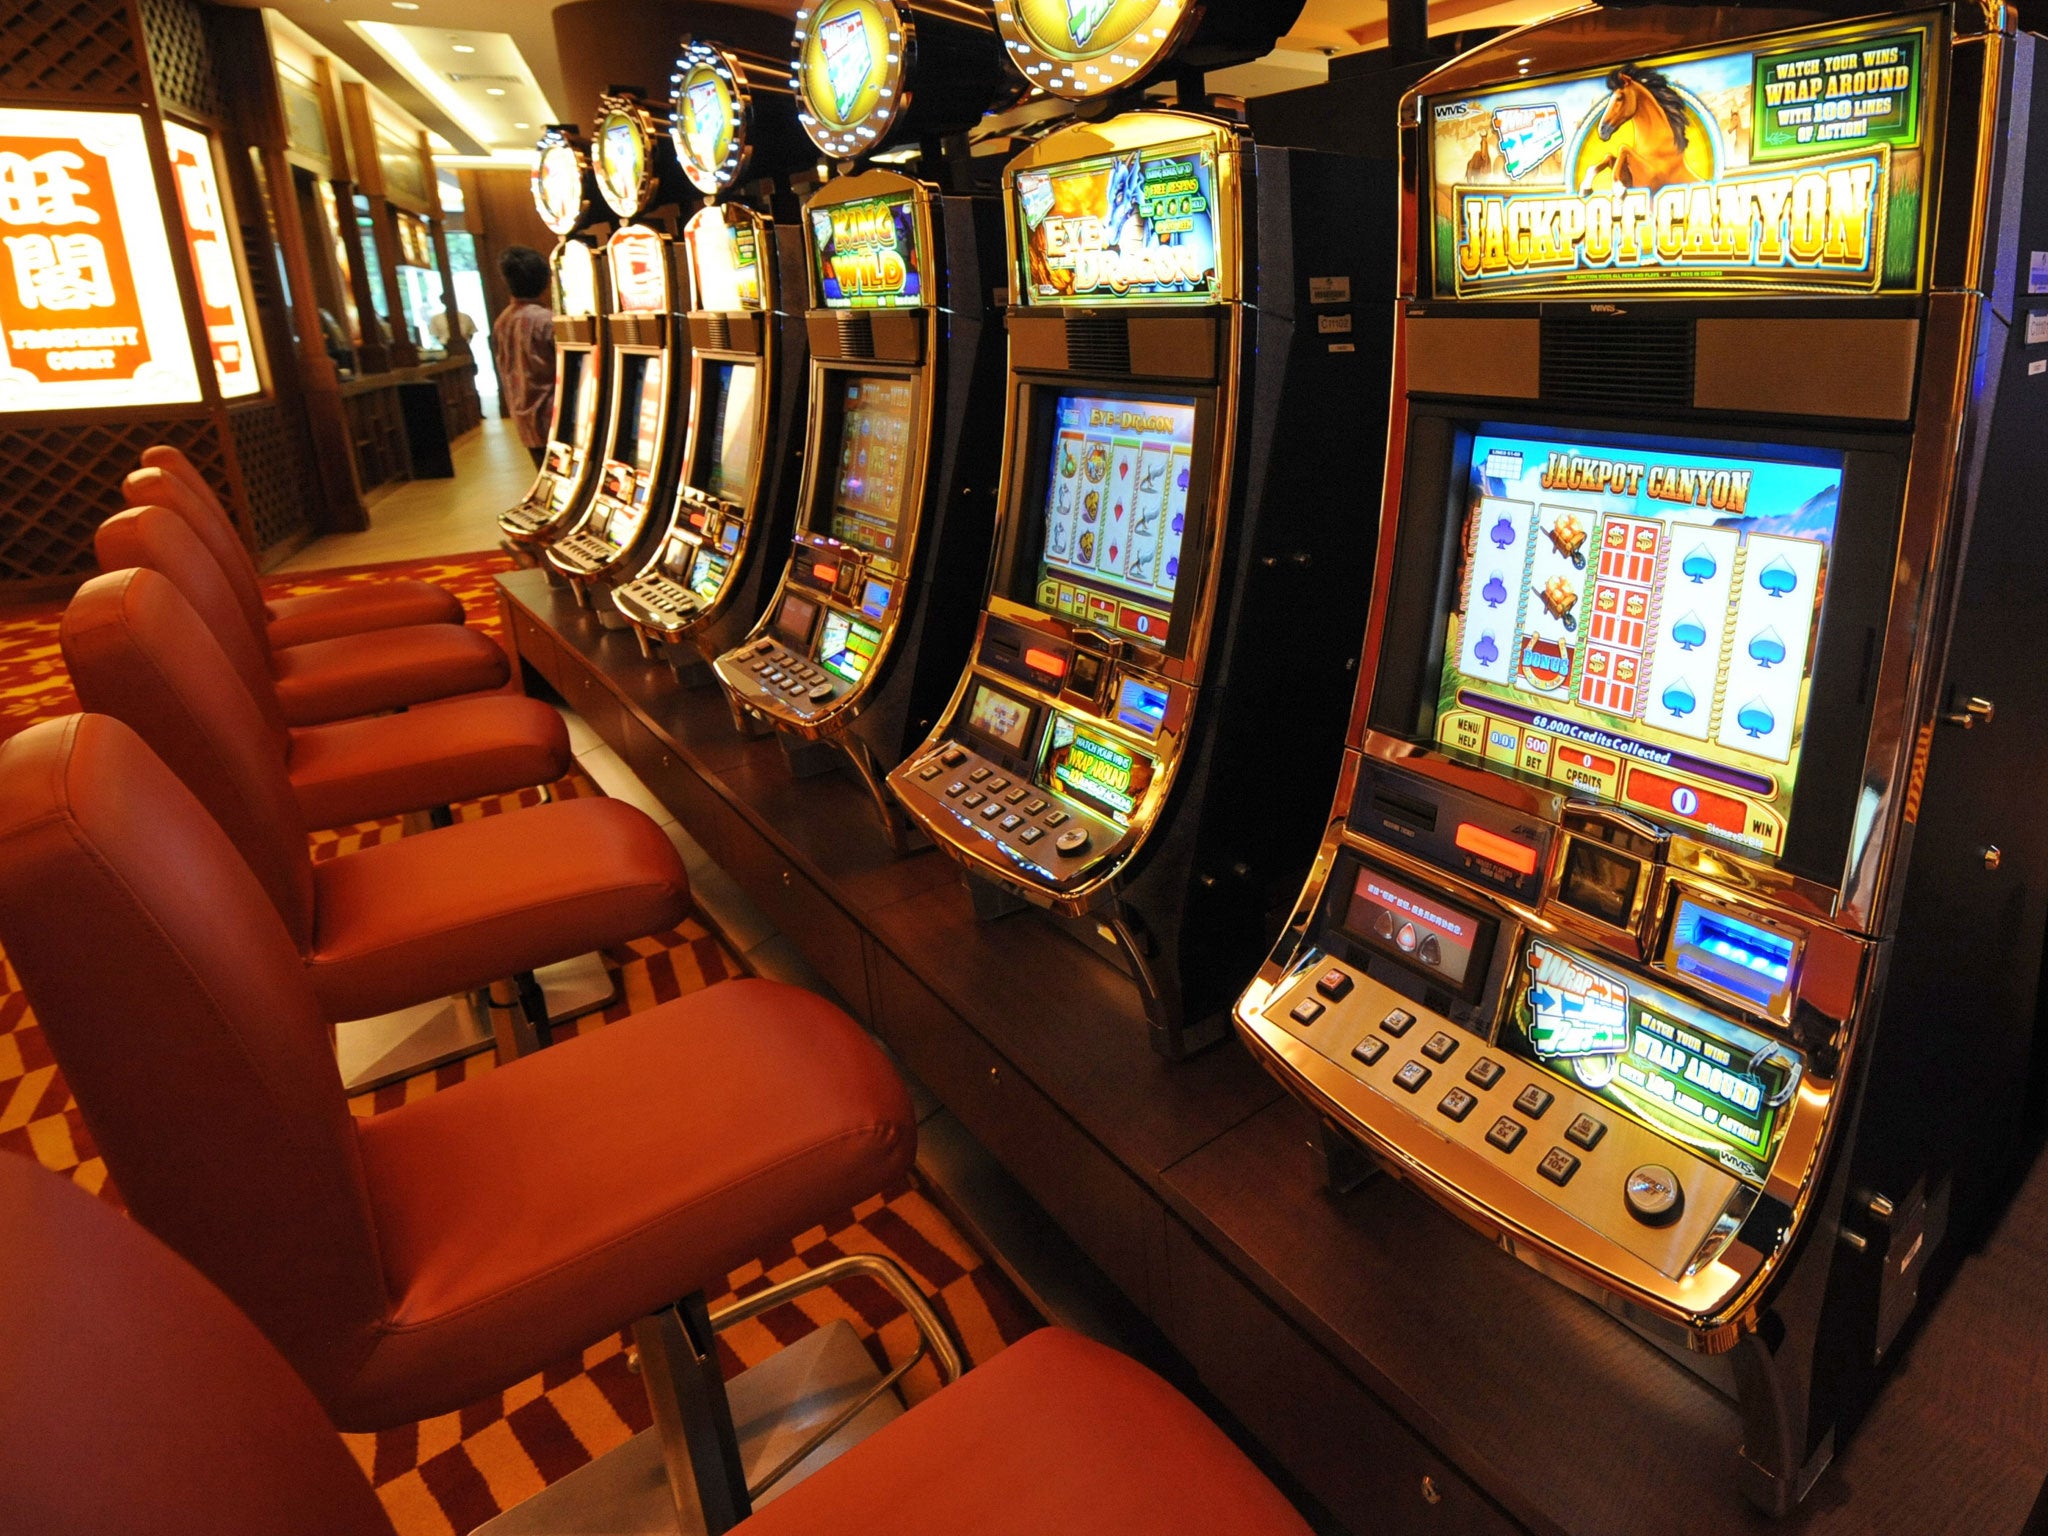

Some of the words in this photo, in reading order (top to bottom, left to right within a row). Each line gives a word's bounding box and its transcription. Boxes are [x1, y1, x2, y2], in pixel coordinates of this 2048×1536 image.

[1776, 59, 1821, 80] WATCH
[1824, 53, 1858, 73] YOUR
[1862, 47, 1899, 67] WINS
[1765, 77, 1823, 106] WRAP
[1824, 66, 1910, 99] AROUND
[1435, 103, 1468, 119] WMS
[1778, 107, 1812, 126] WITH
[1813, 99, 1852, 123] 100
[1853, 97, 1892, 117] LINES
[1797, 126, 1814, 142] OF
[1816, 118, 1868, 141] ACTION!
[831, 202, 895, 252] KING
[1459, 192, 1650, 276] JACKPOT
[1654, 163, 1874, 269] CANYON
[1043, 216, 1102, 258] EYE
[831, 251, 906, 294] WILD
[1590, 304, 1616, 313] WMS
[1089, 408, 1115, 428] EYE
[1120, 410, 1175, 435] DRAGON
[1540, 450, 1644, 497] JACKPOT
[1647, 464, 1753, 515] CANYON
[1136, 614, 1150, 634] 0
[1522, 648, 1570, 676] BONUS
[1457, 718, 1481, 735] MENU/
[1076, 736, 1098, 755] WATCH
[1457, 734, 1477, 748] HELP
[1490, 730, 1518, 750] 0.01
[1525, 735, 1549, 754] 500
[1532, 715, 1570, 736] 68,000
[1569, 725, 1612, 749] Credits
[1612, 737, 1672, 766] Collected
[1069, 747, 1094, 772] WRAP
[1090, 759, 1129, 791] AROUND
[1526, 755, 1542, 770] BET
[1582, 754, 1592, 768] 0
[1566, 767, 1602, 790] CREDITS
[1671, 786, 1699, 817] 0
[1752, 819, 1774, 838] WIN
[1641, 1011, 1675, 1040] WATCH
[1675, 1029, 1702, 1053] YOUR
[1703, 1042, 1731, 1066] WINS
[1634, 1030, 1687, 1075] WRAP
[1683, 1057, 1761, 1111] AROUND
[1499, 1120, 1517, 1132] PLAY
[1550, 1151, 1570, 1164] PLAY
[1720, 1150, 1752, 1174] WMS
